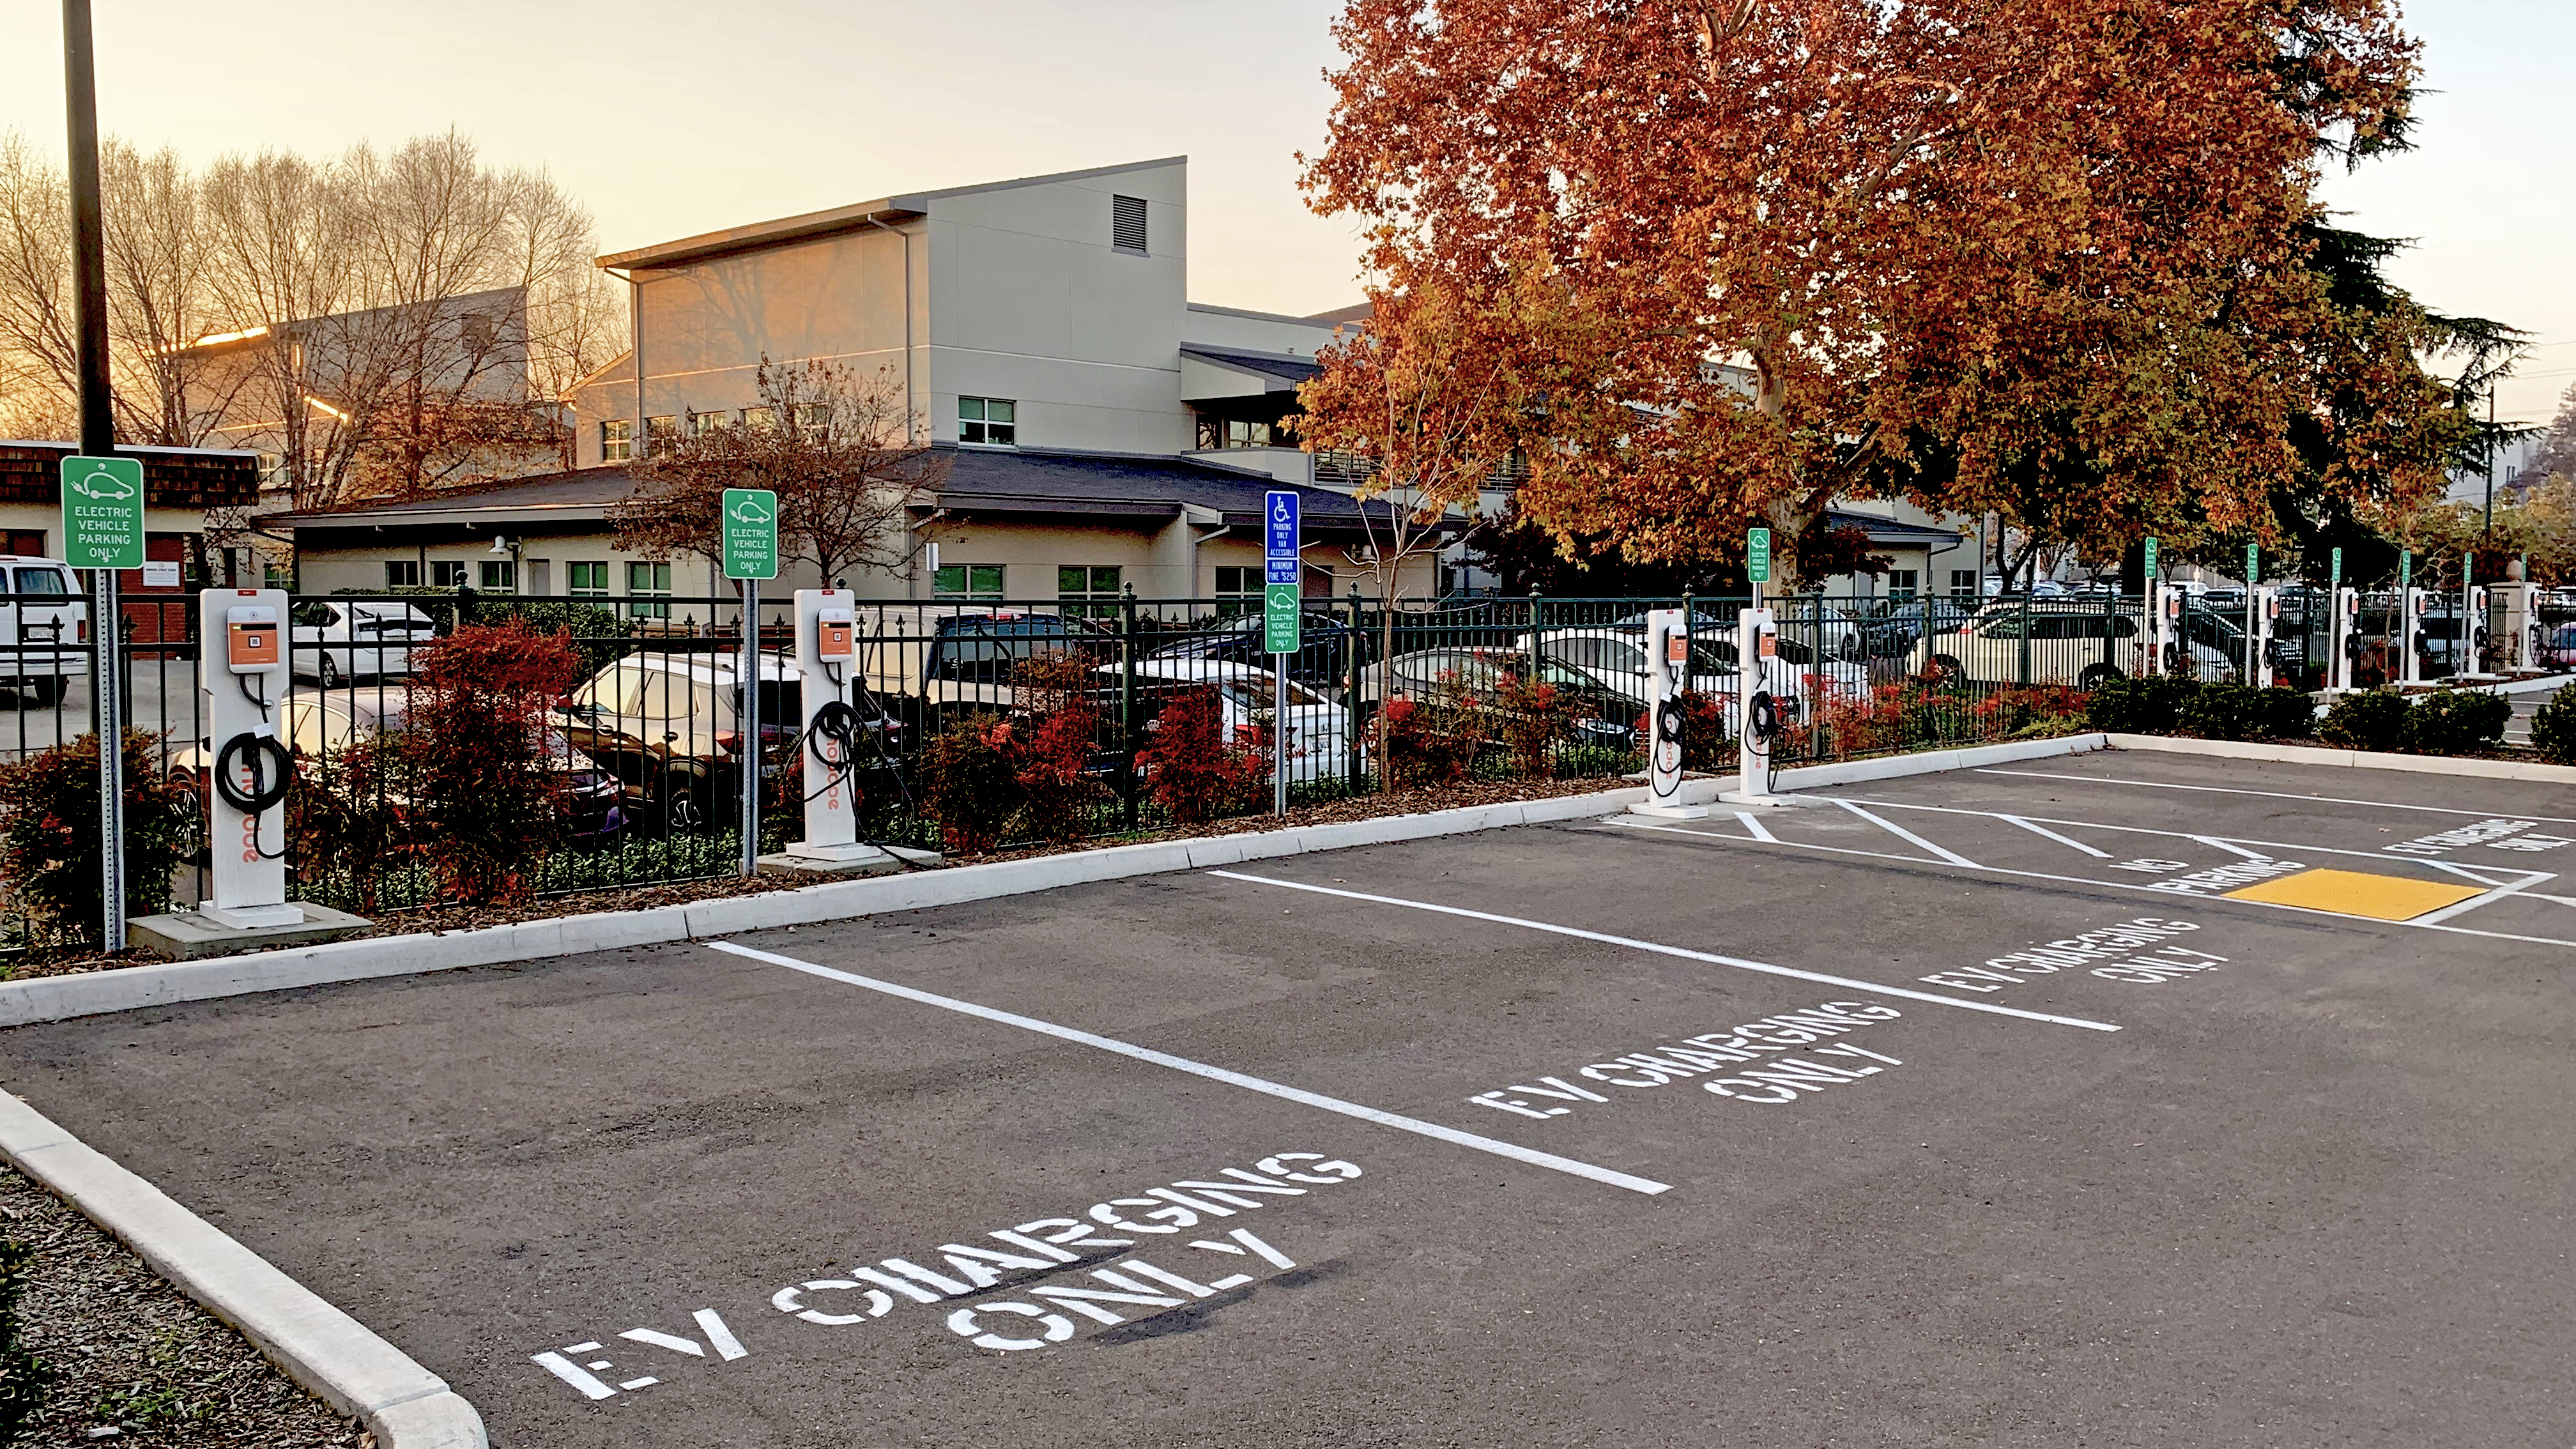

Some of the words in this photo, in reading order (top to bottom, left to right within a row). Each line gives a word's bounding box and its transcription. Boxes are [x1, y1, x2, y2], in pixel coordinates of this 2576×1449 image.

[75, 506, 132, 518] ELECTRIC
[78, 519, 130, 531] VEHICLE
[1273, 523, 1292, 531] PARKING
[78, 533, 131, 544] PARKING
[731, 528, 769, 538] ELECTRIC
[733, 540, 768, 548] VEHICLE
[89, 548, 121, 558] ONLY
[733, 550, 768, 560] PARKING
[740, 561, 762, 571] ONLY
[1271, 561, 1293, 570] MINIMUM
[1268, 571, 1279, 581] FINE
[1280, 571, 1296, 581] $250
[2108, 859, 2189, 873] NO
[2147, 859, 2306, 894] PARKING
[1918, 966, 2025, 993] EV
[1985, 917, 2200, 974] CHARGING
[2090, 946, 2228, 983] ONLY
[1471, 1077, 1609, 1119] EV
[1581, 1002, 1902, 1087] CHARGING
[1704, 1043, 1903, 1103] ONLY
[530, 1307, 749, 1400] EV
[771, 1152, 1363, 1326] CHARGING
[947, 1228, 1296, 1351] ONLY
